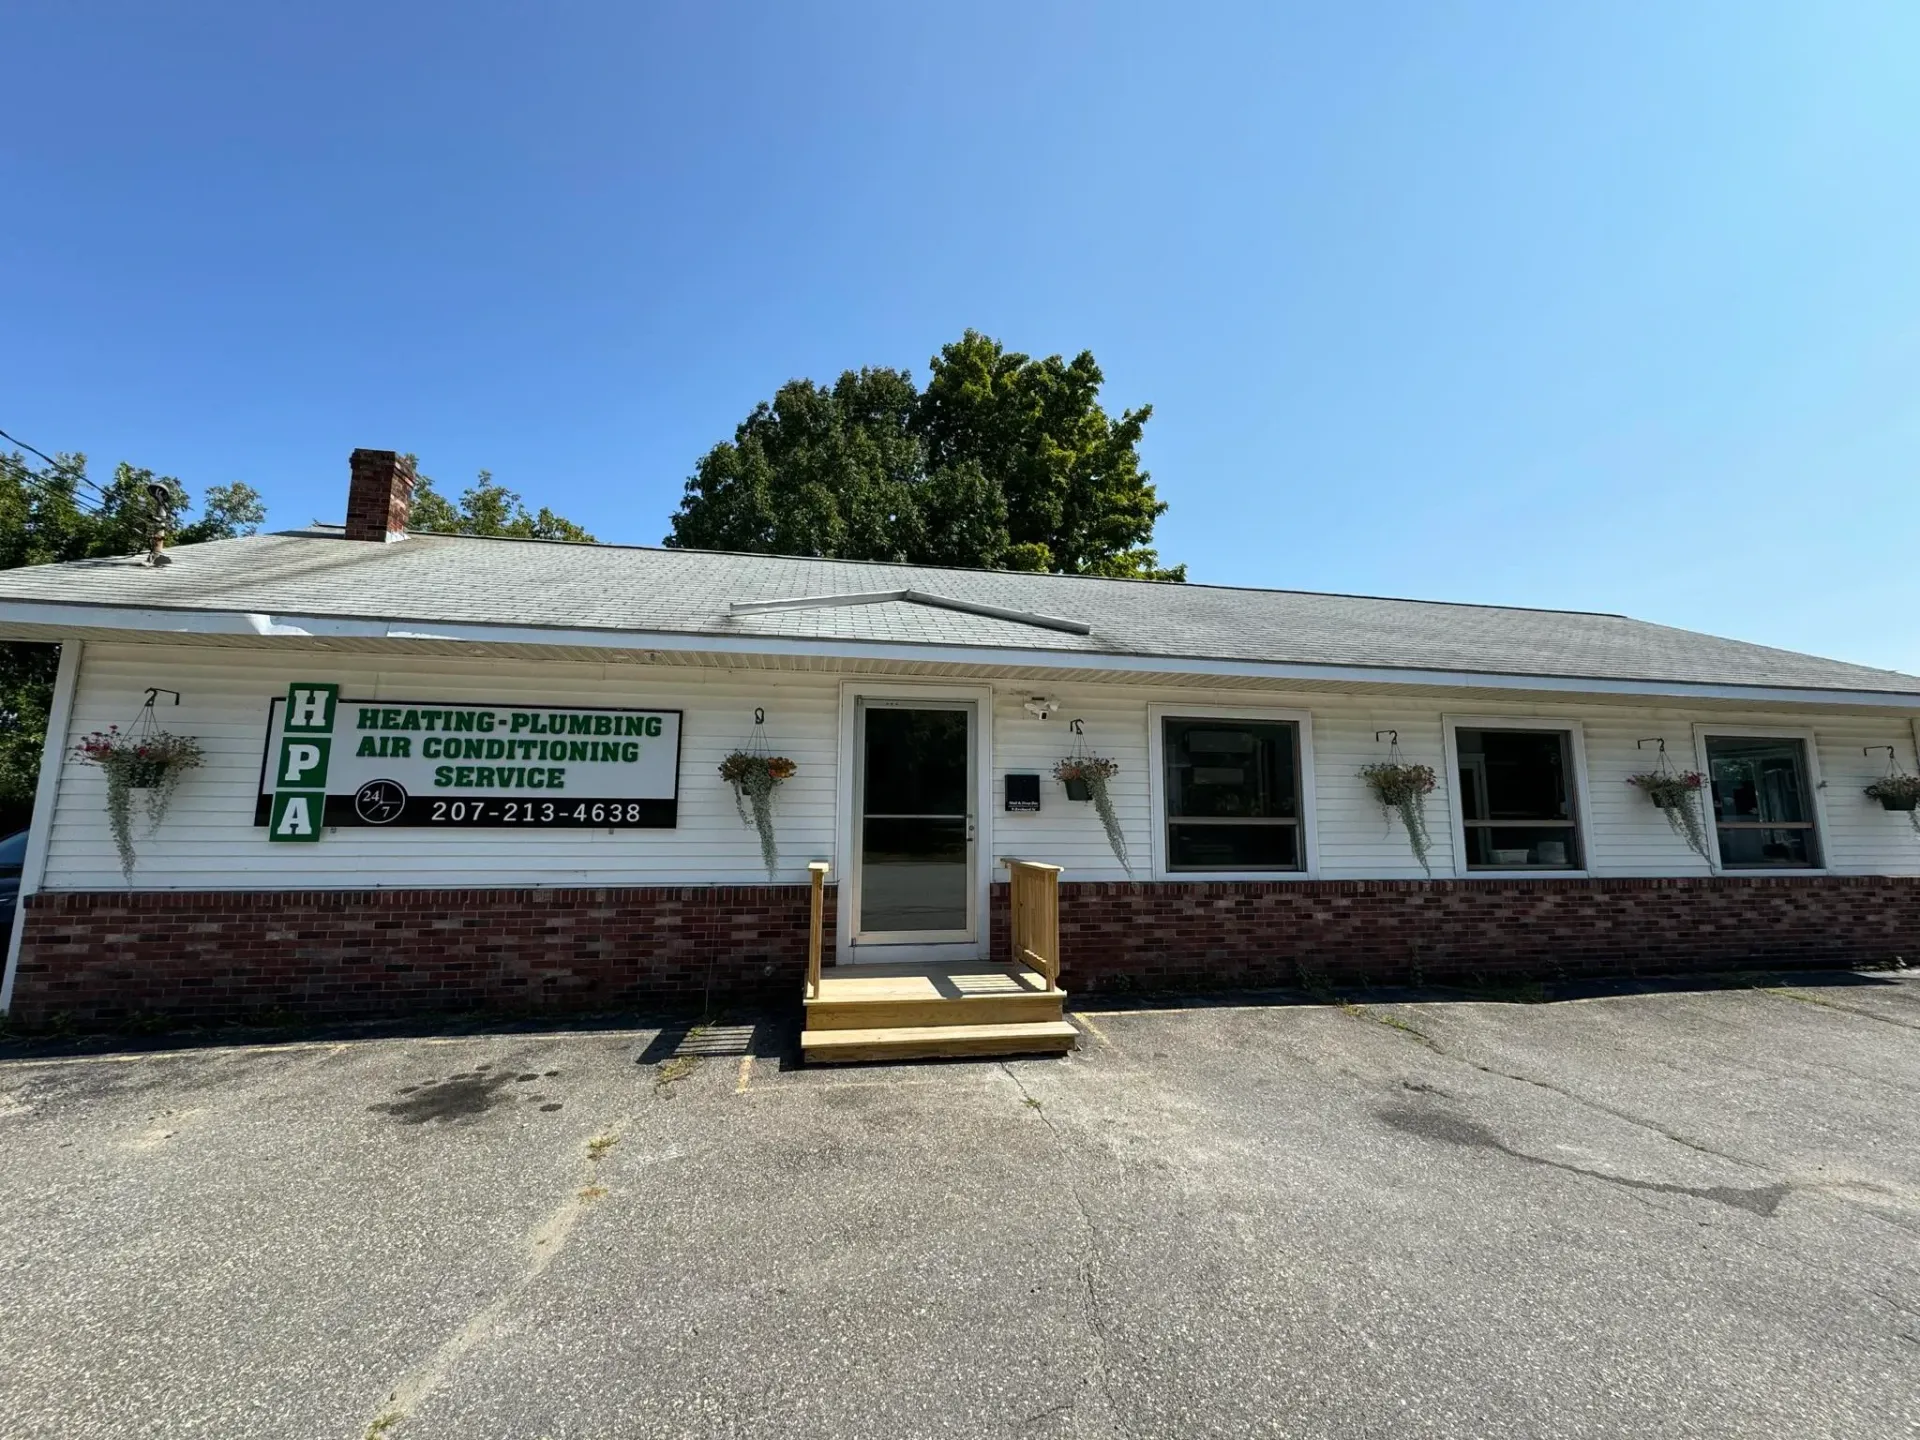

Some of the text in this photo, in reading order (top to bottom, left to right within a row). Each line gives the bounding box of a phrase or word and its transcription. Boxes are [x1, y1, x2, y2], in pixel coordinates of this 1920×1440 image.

[356, 708, 662, 737] HEATING-PLUMBING
[355, 736, 639, 762] AIR CONDITIONING
[434, 766, 565, 789] SERVICE
[362, 790, 390, 817] 24 7
[431, 802, 640, 822] 207-213-4638
